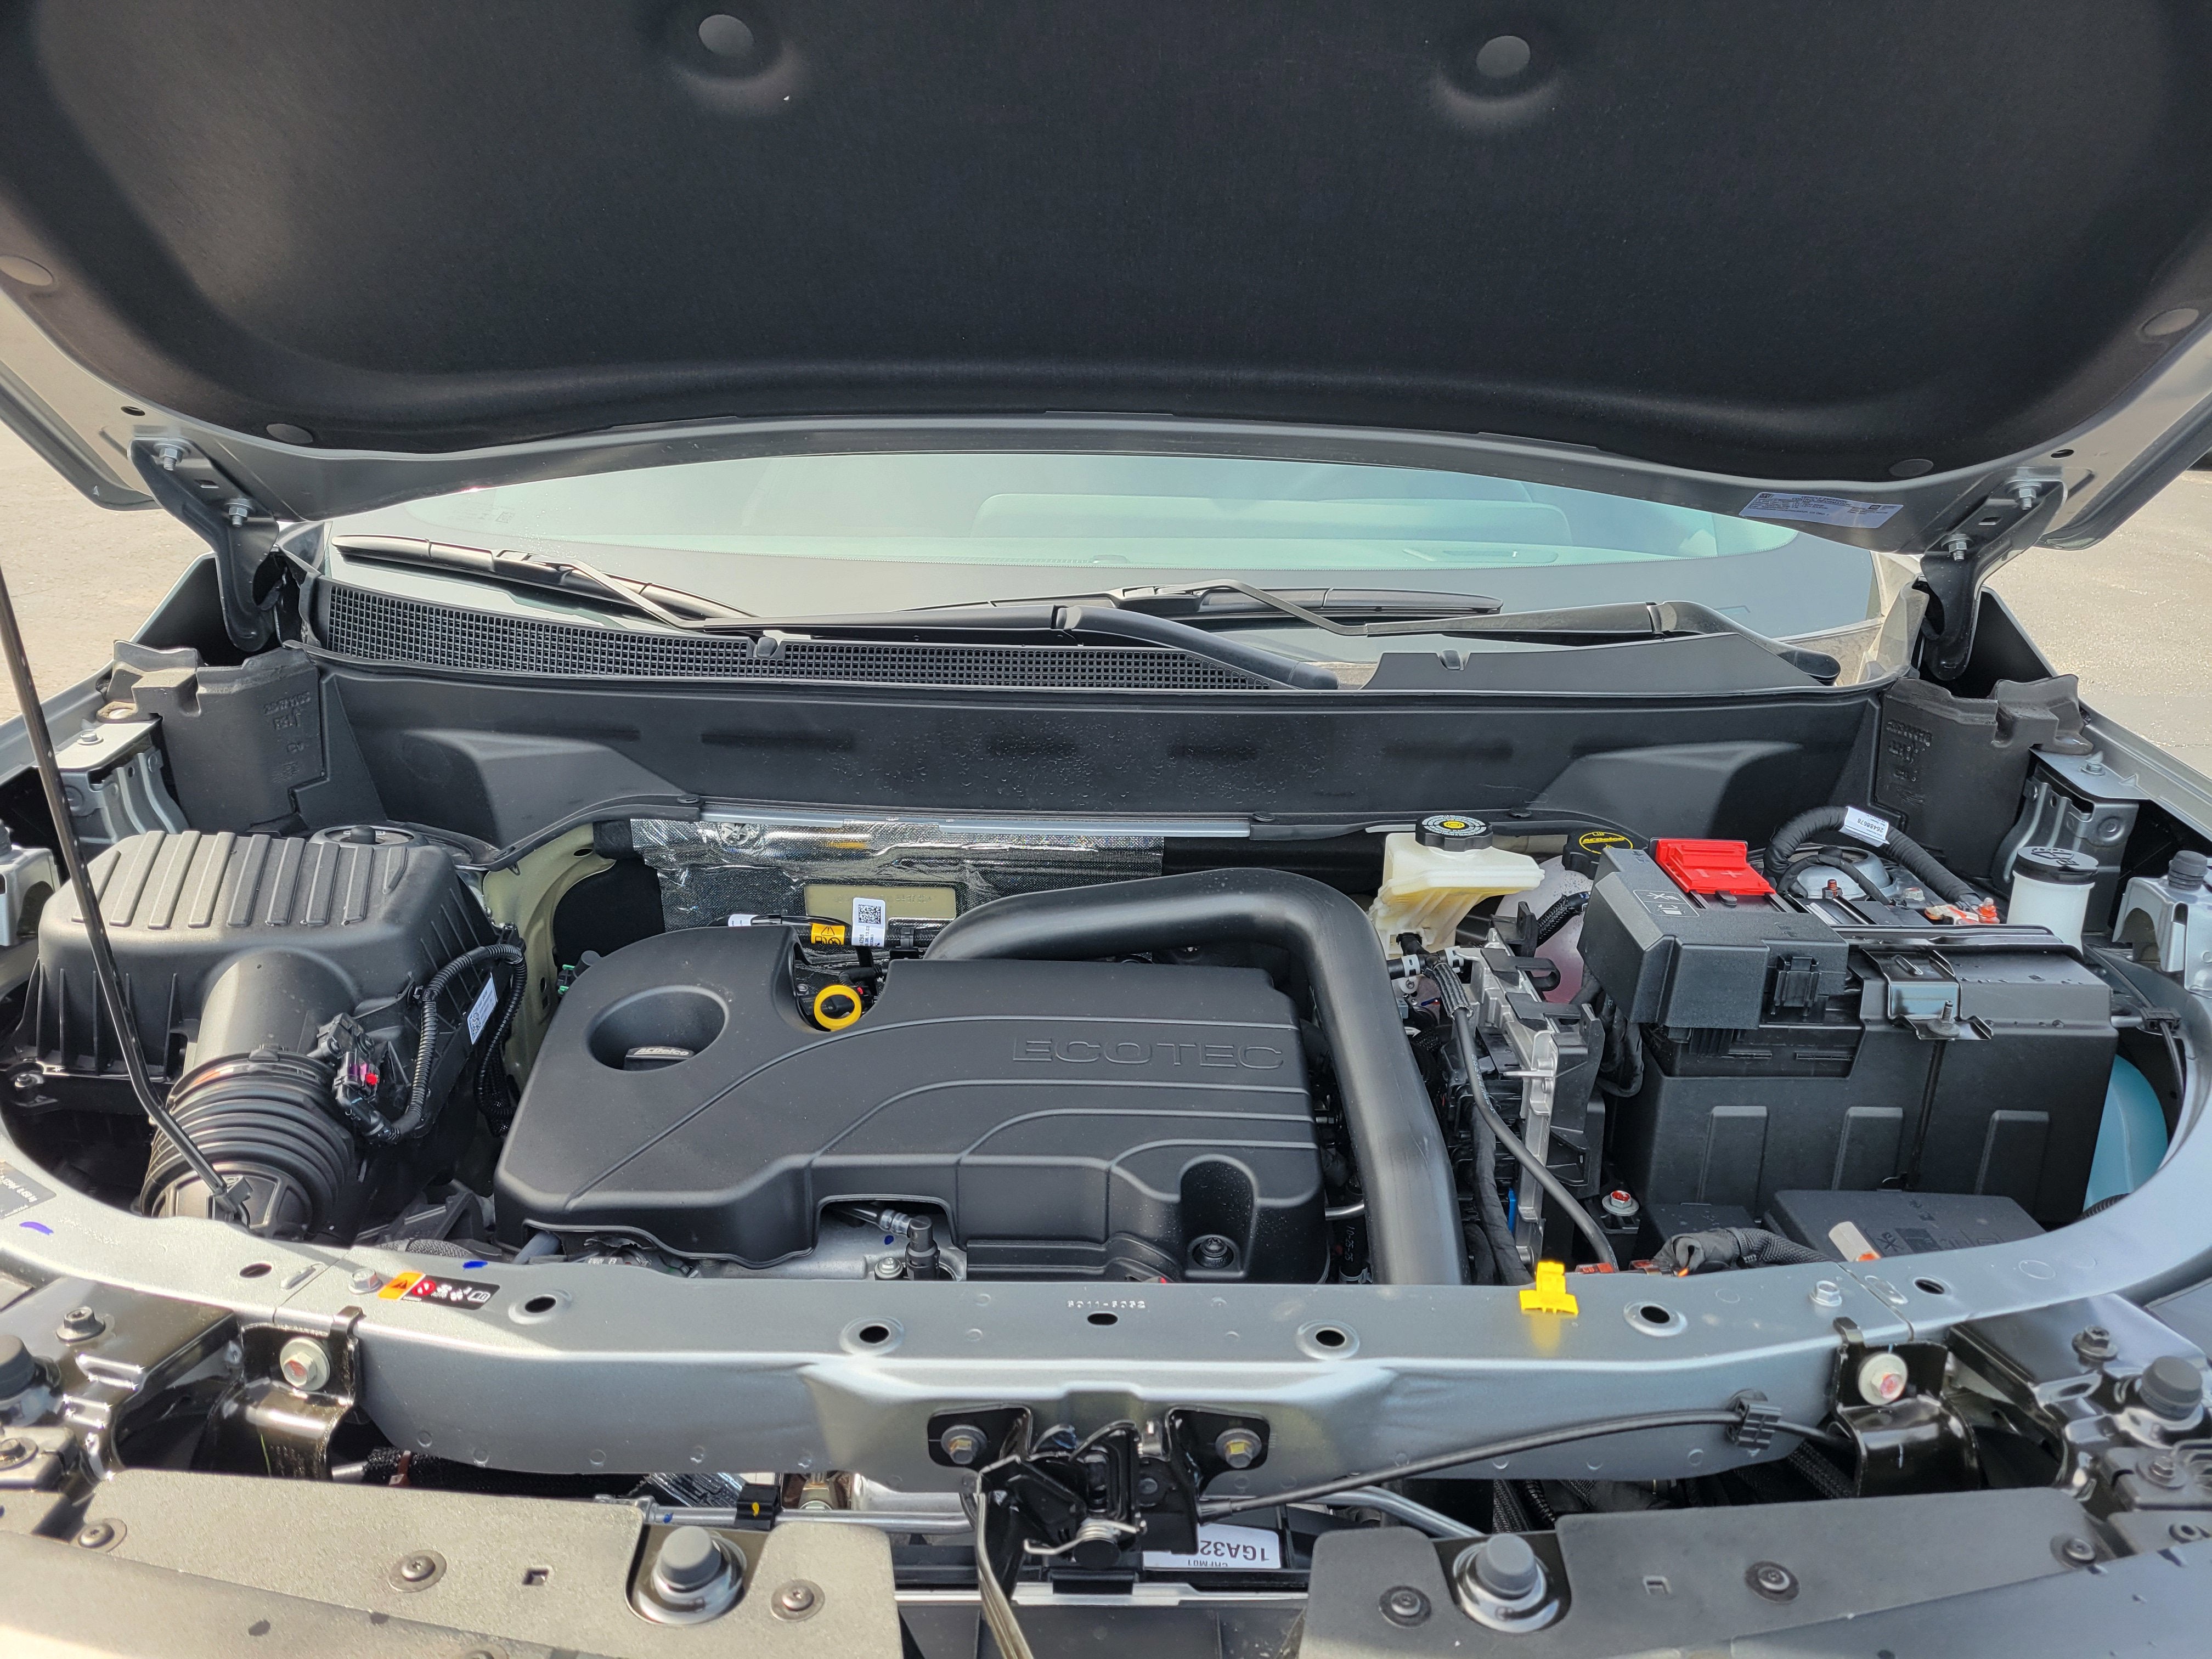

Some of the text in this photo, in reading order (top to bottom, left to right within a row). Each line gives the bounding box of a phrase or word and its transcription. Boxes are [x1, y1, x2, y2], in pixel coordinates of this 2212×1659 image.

[634, 1047, 690, 1056] ACDelco
[1012, 1036, 1284, 1070] ECOTEC
[1199, 1540, 1270, 1562] 1GA32
